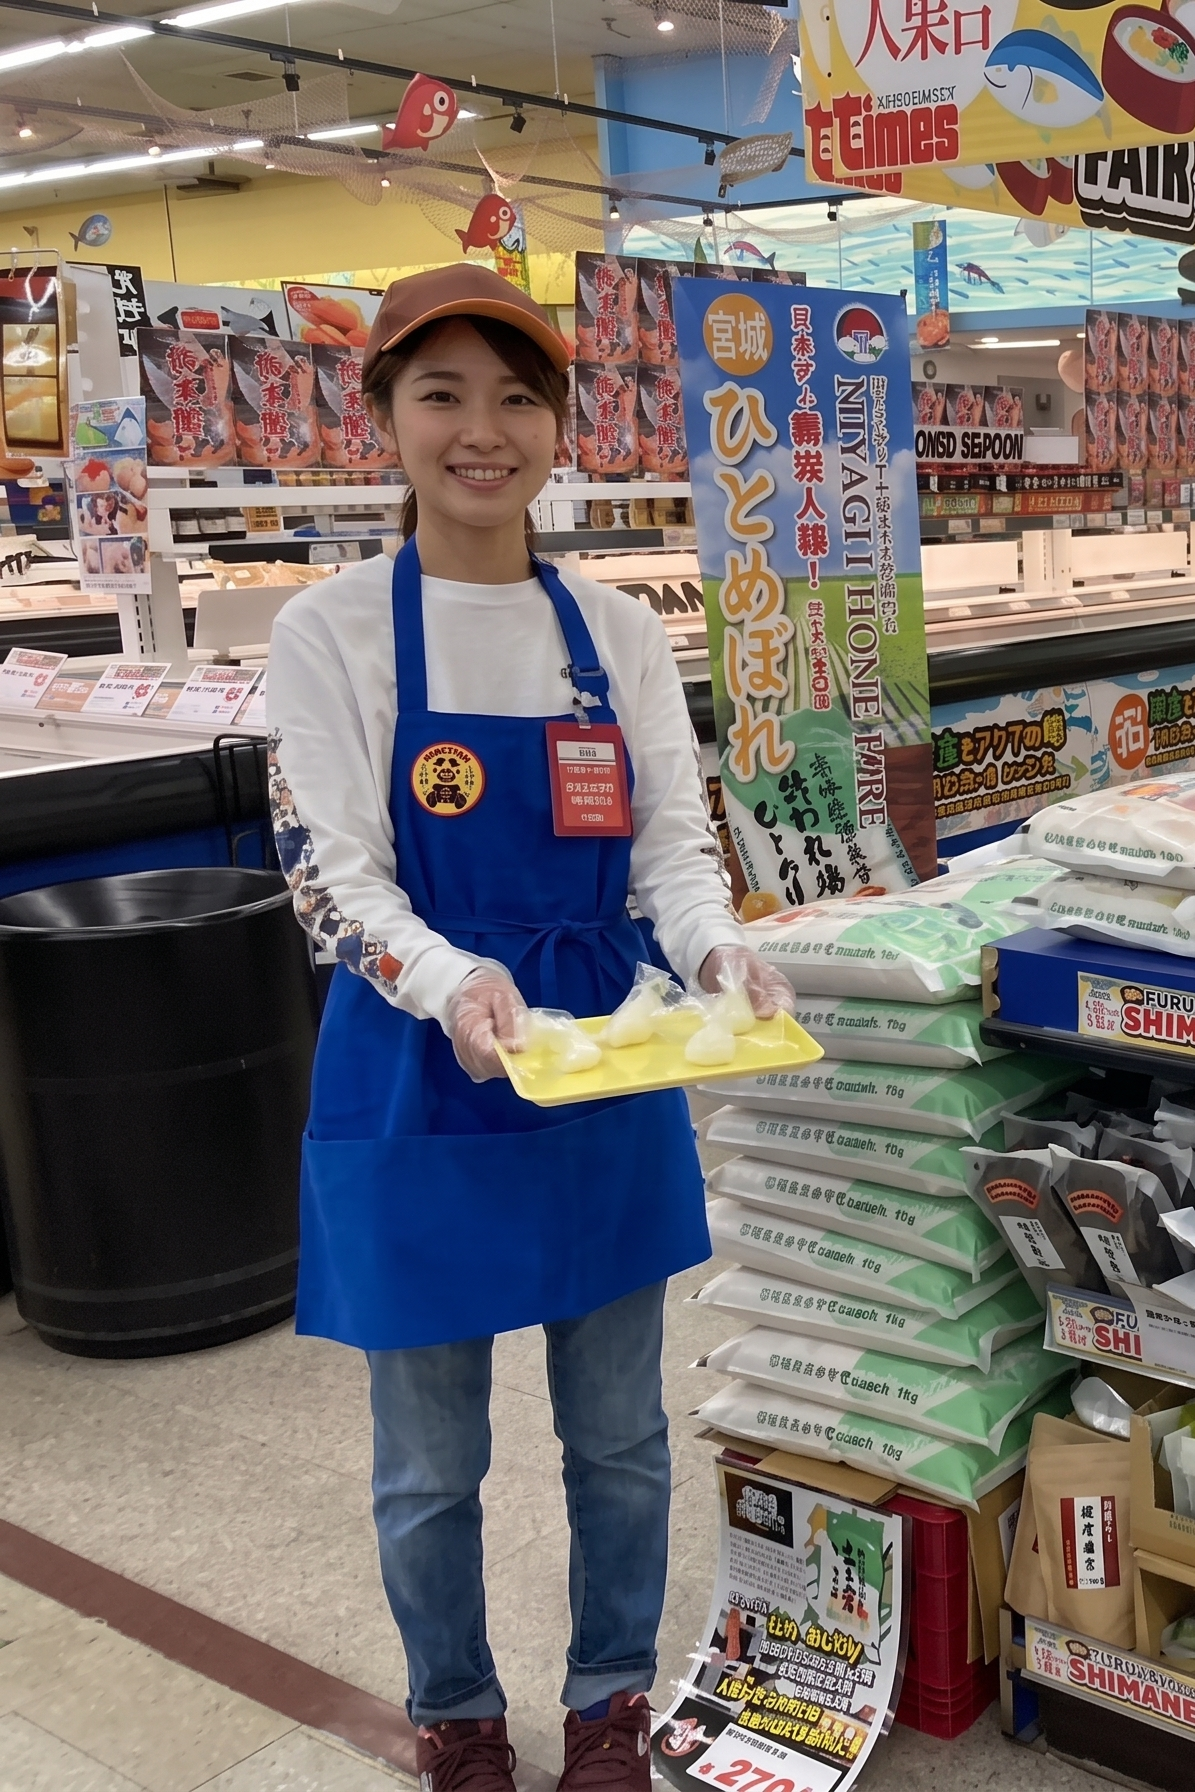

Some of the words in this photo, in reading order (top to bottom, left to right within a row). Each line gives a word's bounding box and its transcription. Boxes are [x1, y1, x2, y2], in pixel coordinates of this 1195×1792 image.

[708, 311, 769, 362] 宮城
[708, 385, 793, 777] ひとめぼれ
